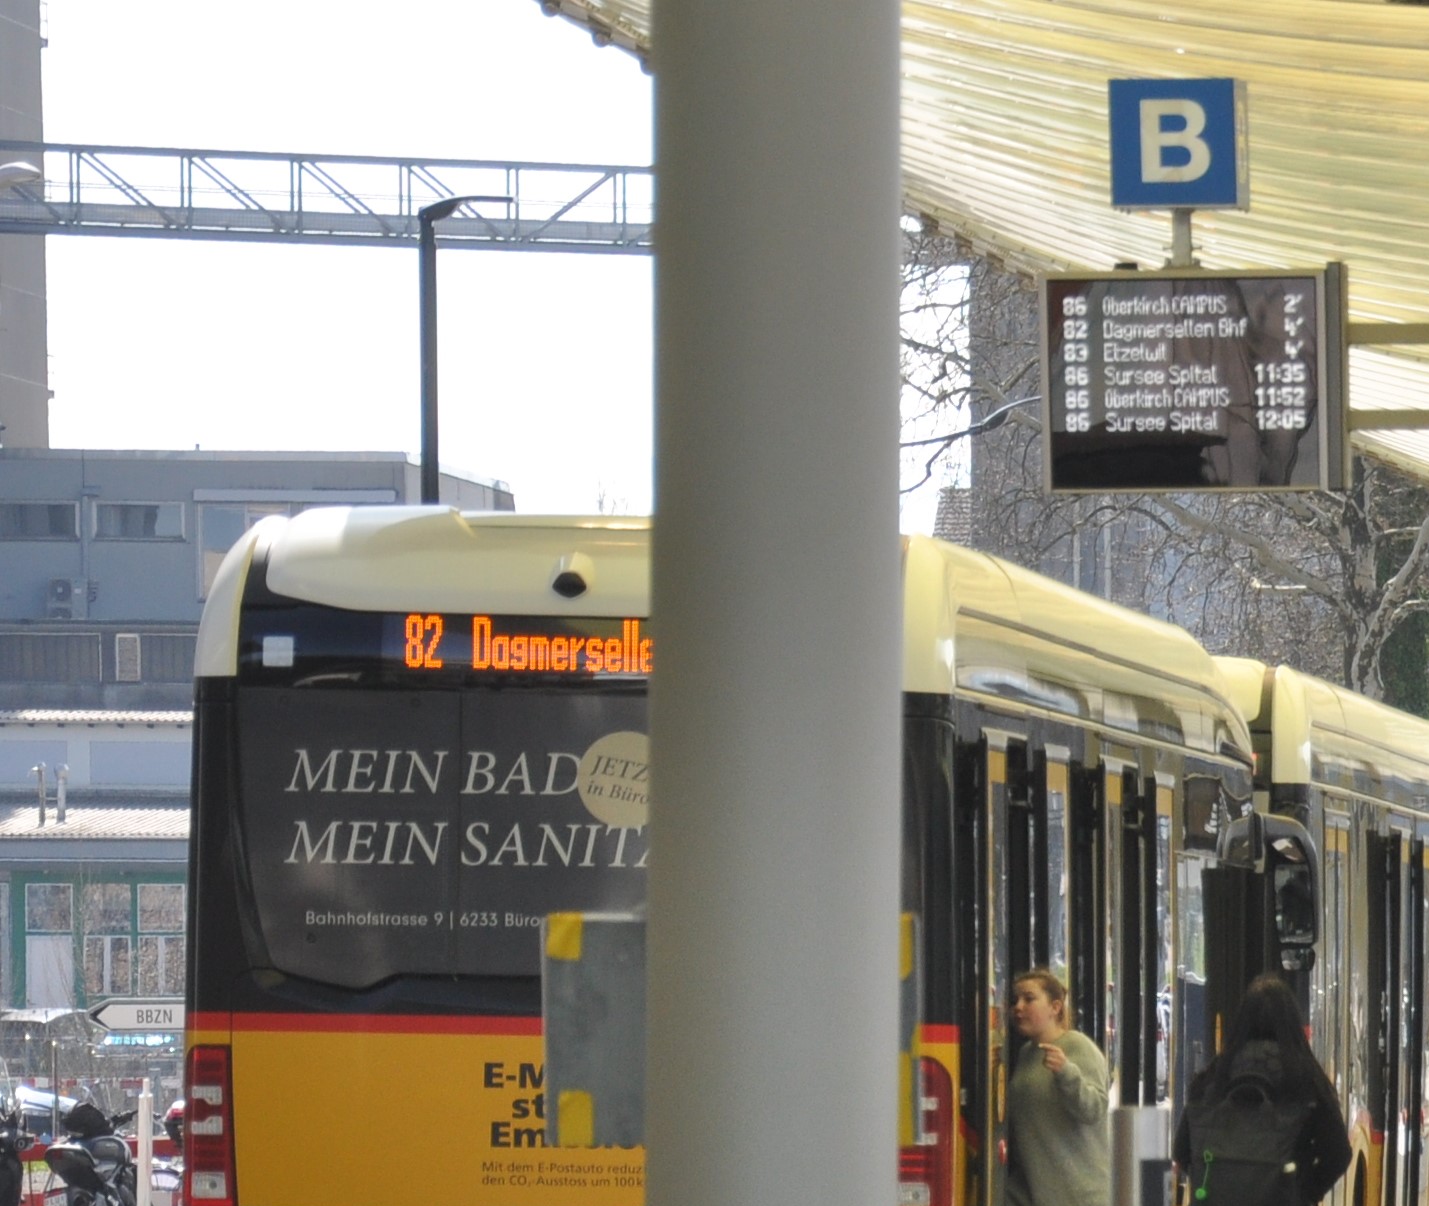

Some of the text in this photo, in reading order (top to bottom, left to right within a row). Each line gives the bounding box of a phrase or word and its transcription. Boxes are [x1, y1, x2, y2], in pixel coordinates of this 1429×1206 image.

[1140, 98, 1212, 184] B
[1062, 296, 1087, 316] 86
[1102, 296, 1169, 315] Oberkirch
[1171, 295, 1227, 315] CAMPUS
[1063, 320, 1088, 339] 82
[1102, 319, 1215, 342] Dagmersellen
[1217, 317, 1248, 338] Bhf
[1063, 343, 1089, 362] 83
[1102, 343, 1167, 362] Etzelwil
[1064, 363, 1306, 386] 86 Sursee Spital 11:35
[1065, 386, 1306, 409] 86 Oberkirch CAMPUS 11:52
[1065, 410, 1307, 433] 86 Sursee Spital 12:05
[404, 613, 444, 669] 82
[284, 749, 584, 796] MEIN BAD
[586, 780, 604, 797] in
[283, 820, 449, 866] MEIN
[305, 911, 428, 927] Bahnhofstrasse
[433, 913, 444, 927] 9
[459, 913, 499, 928] 6233
[136, 1009, 173, 1024] BBZN
[482, 1160, 503, 1173] Mit
[506, 1160, 534, 1174] dem
[537, 1161, 603, 1175] E-Postauto
[481, 1174, 506, 1187] den
[590, 1178, 611, 1188] um
